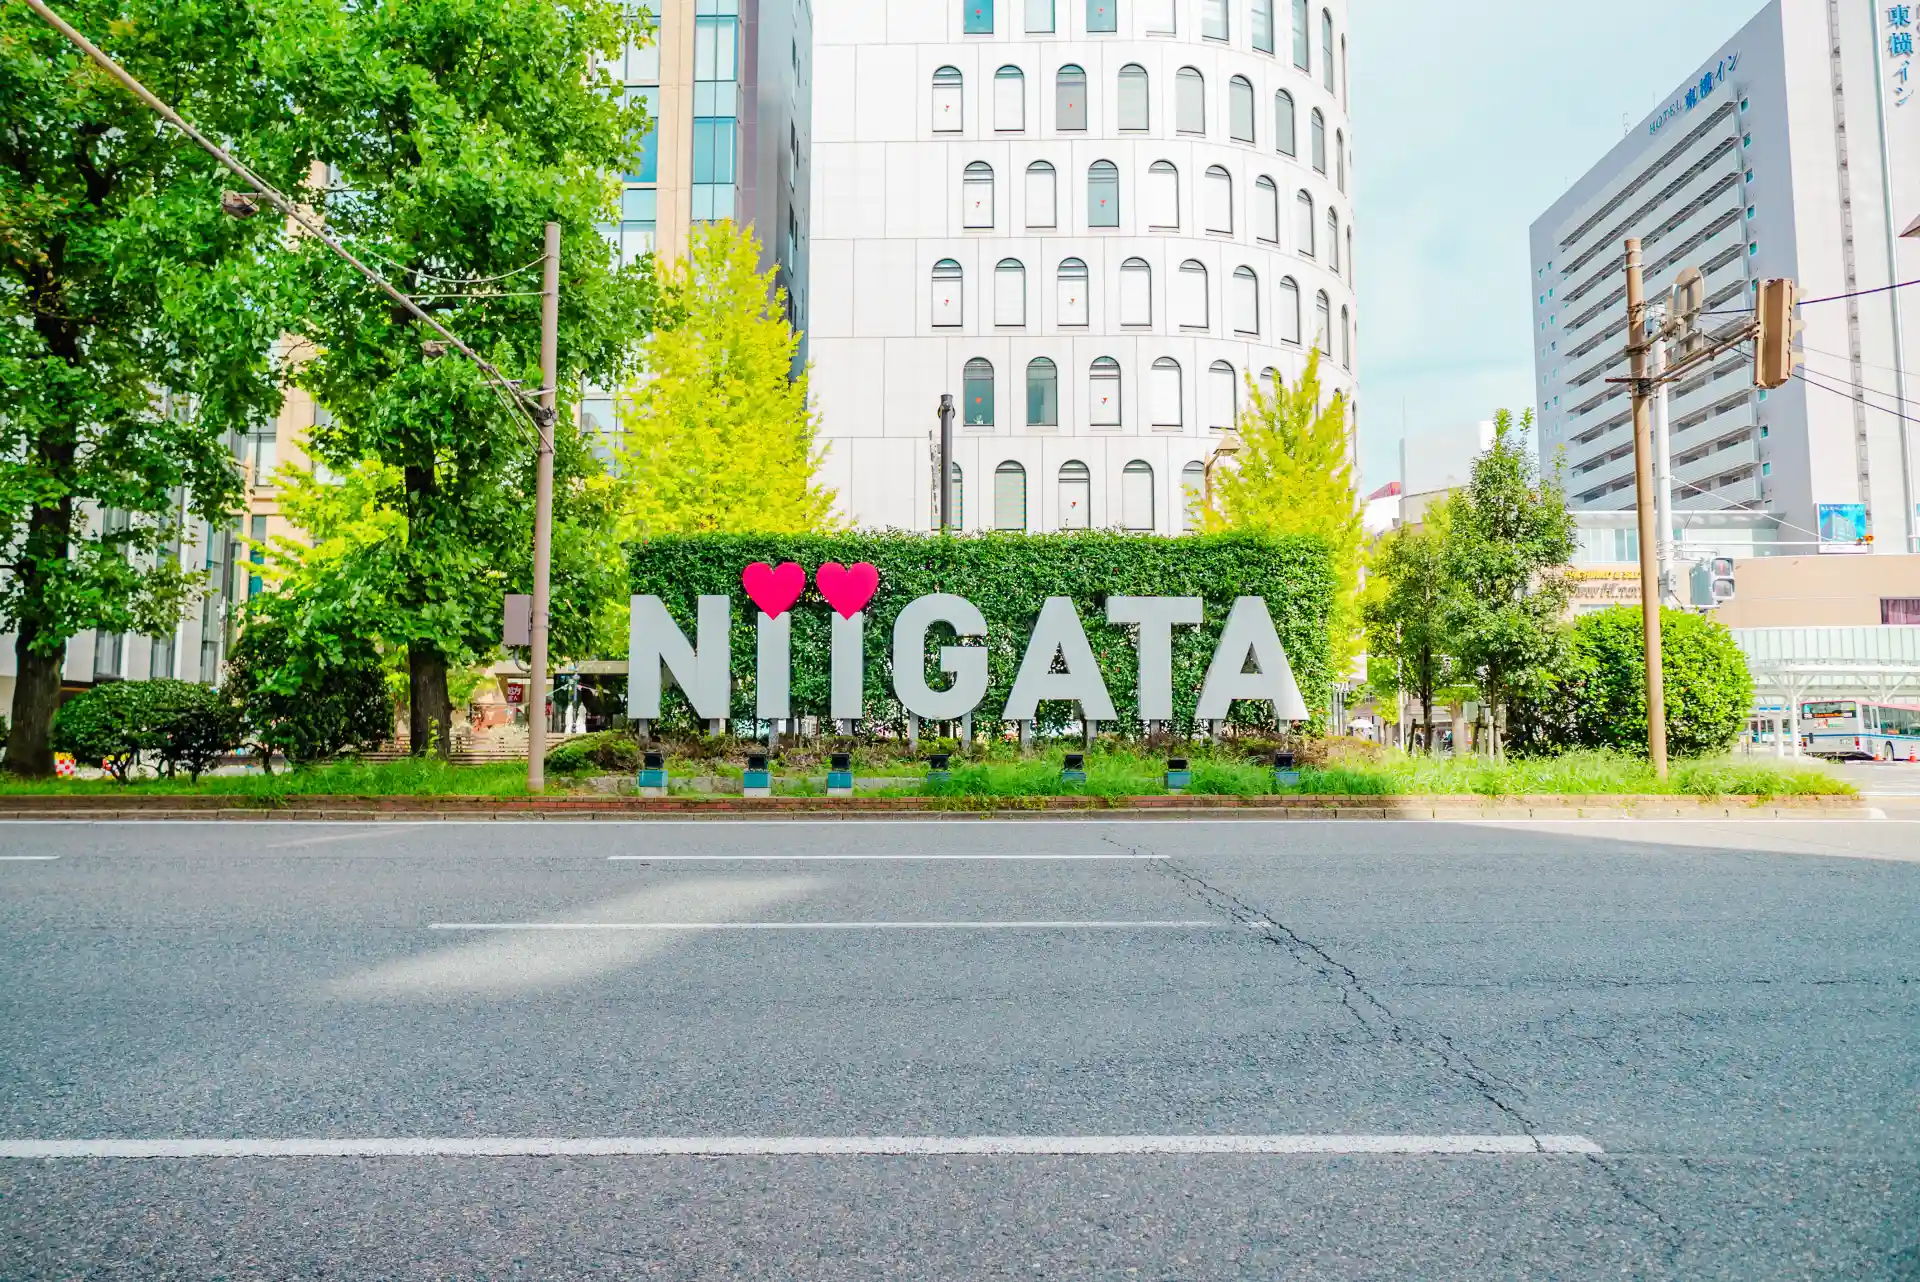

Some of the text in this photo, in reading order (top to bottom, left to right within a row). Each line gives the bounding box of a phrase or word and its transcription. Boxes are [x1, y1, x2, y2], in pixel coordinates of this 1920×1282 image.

[1649, 49, 1740, 135] HOTEL 東横イン
[1886, 4, 1915, 107] 東横イン
